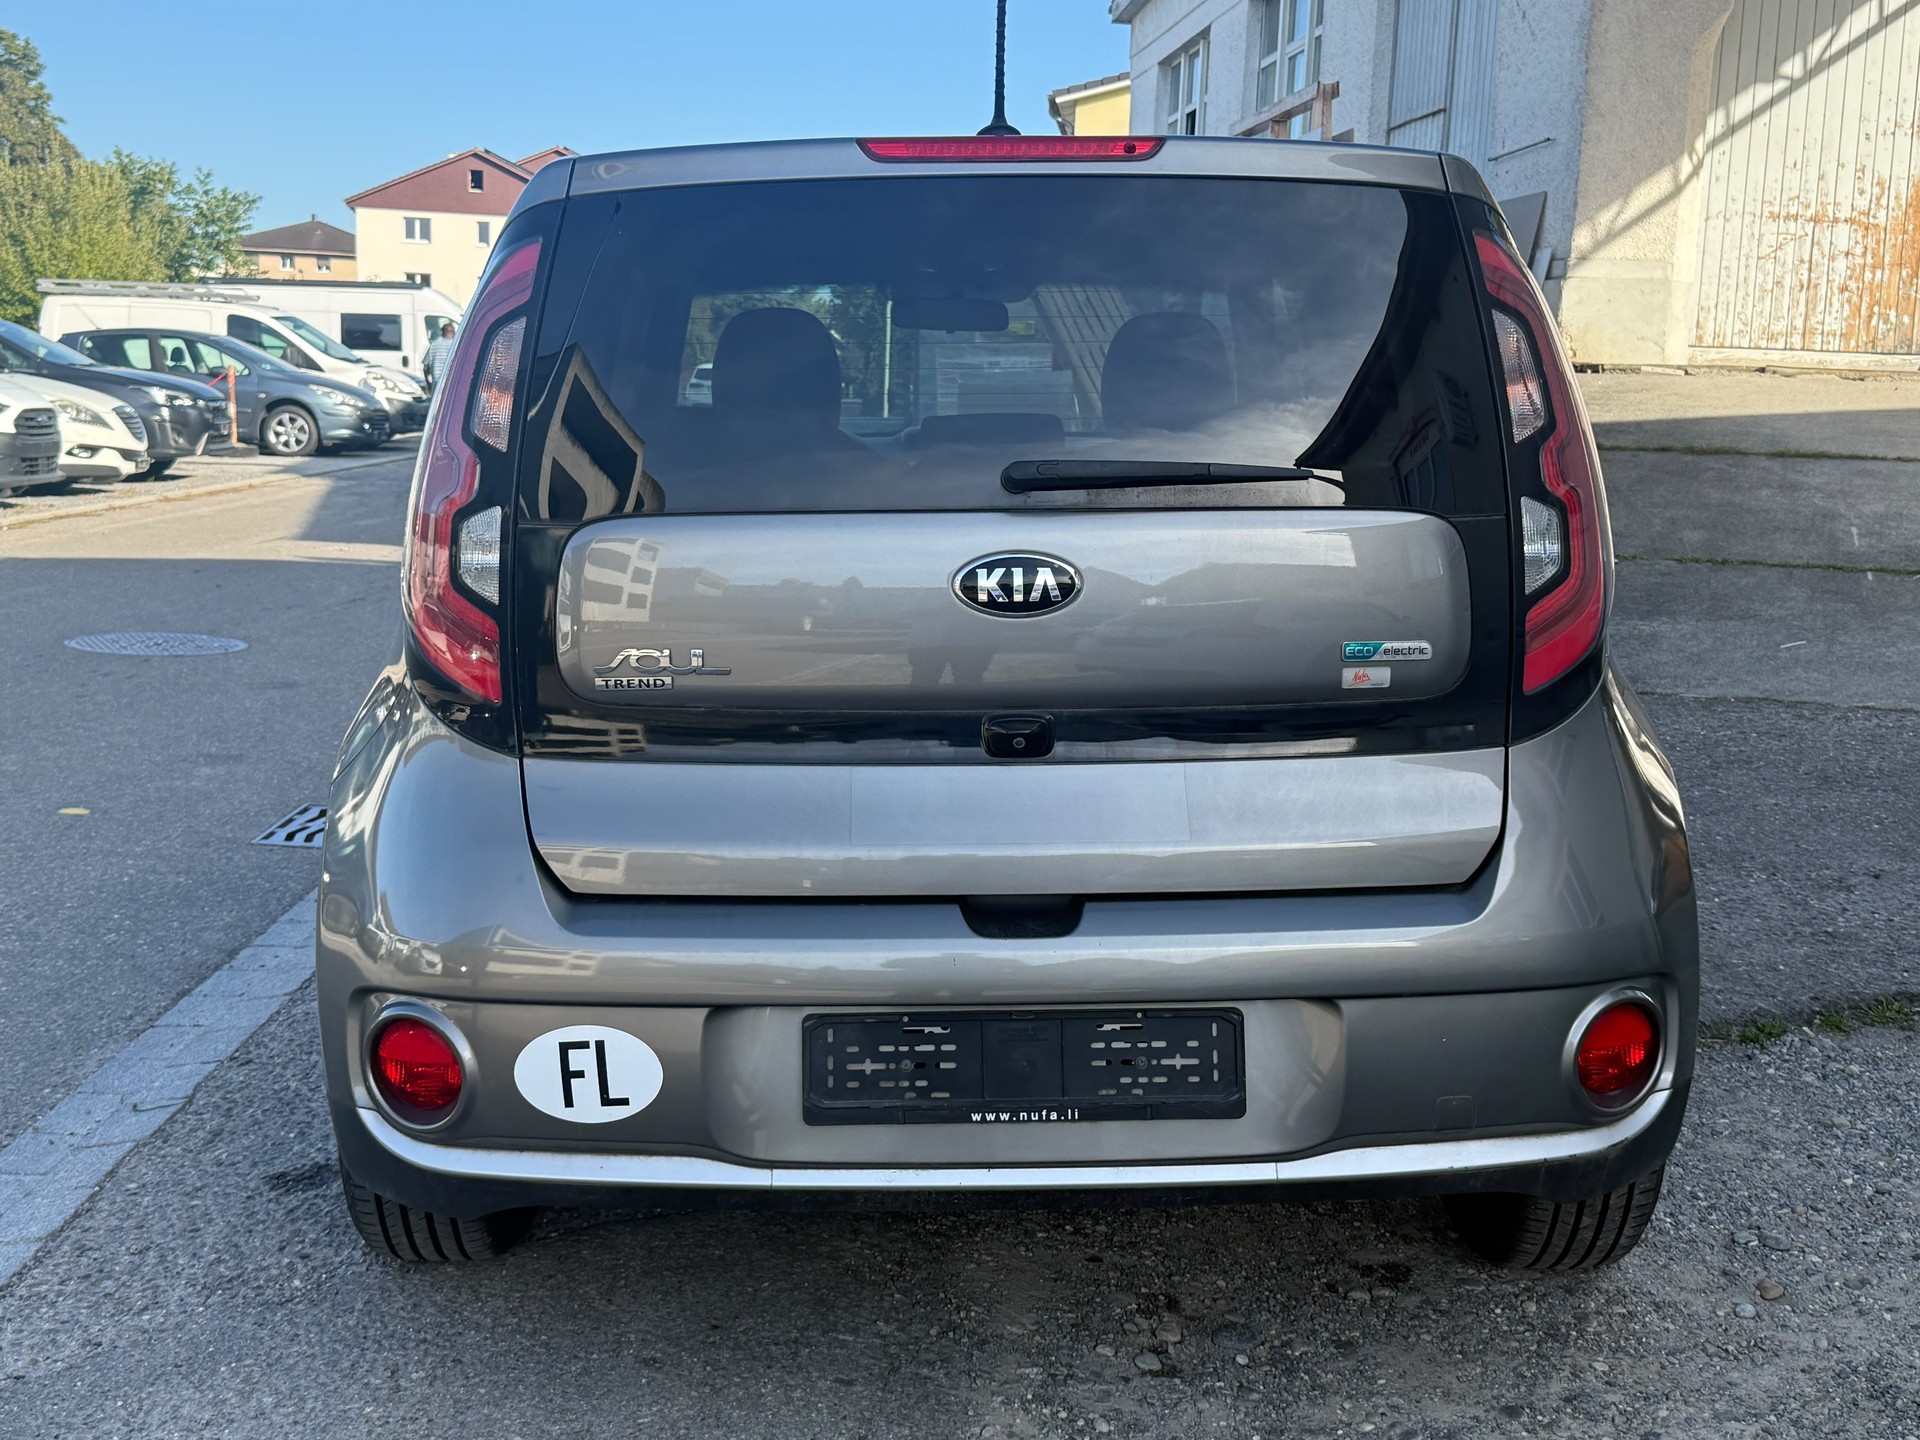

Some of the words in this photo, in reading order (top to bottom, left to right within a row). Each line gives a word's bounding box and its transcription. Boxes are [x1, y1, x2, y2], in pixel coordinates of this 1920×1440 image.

[976, 567, 1062, 602] KIA
[1345, 646, 1374, 656] ECO
[1383, 645, 1429, 656] electric
[601, 678, 666, 689] TREND
[558, 1039, 630, 1108] FL
[971, 1108, 1079, 1121] www.nufa.li
